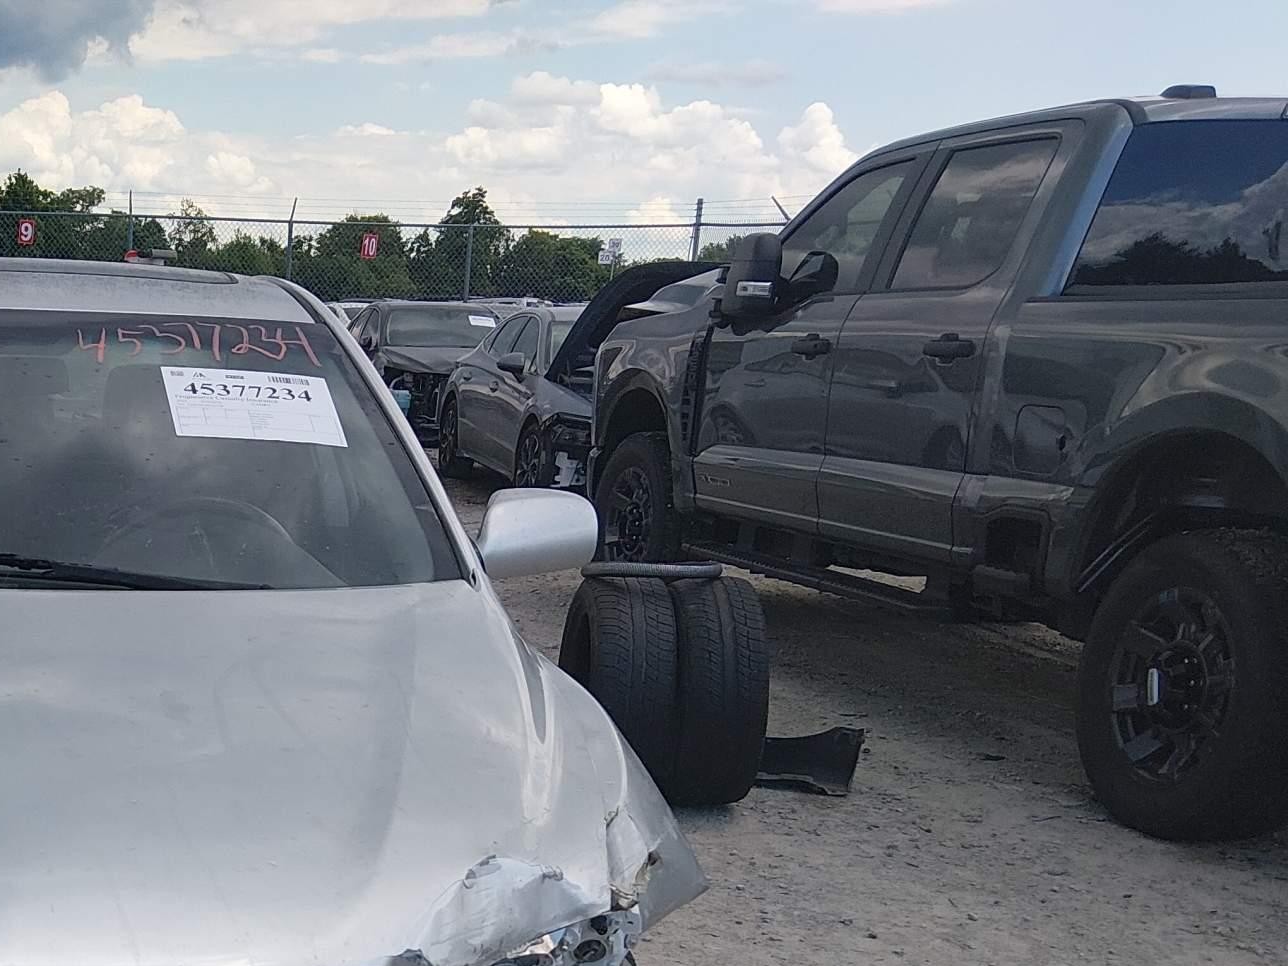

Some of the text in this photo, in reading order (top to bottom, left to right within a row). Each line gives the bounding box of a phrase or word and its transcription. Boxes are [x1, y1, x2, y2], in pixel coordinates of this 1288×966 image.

[20, 222, 33, 242] 9
[363, 236, 376, 256] 10
[183, 382, 313, 402] 45377234
